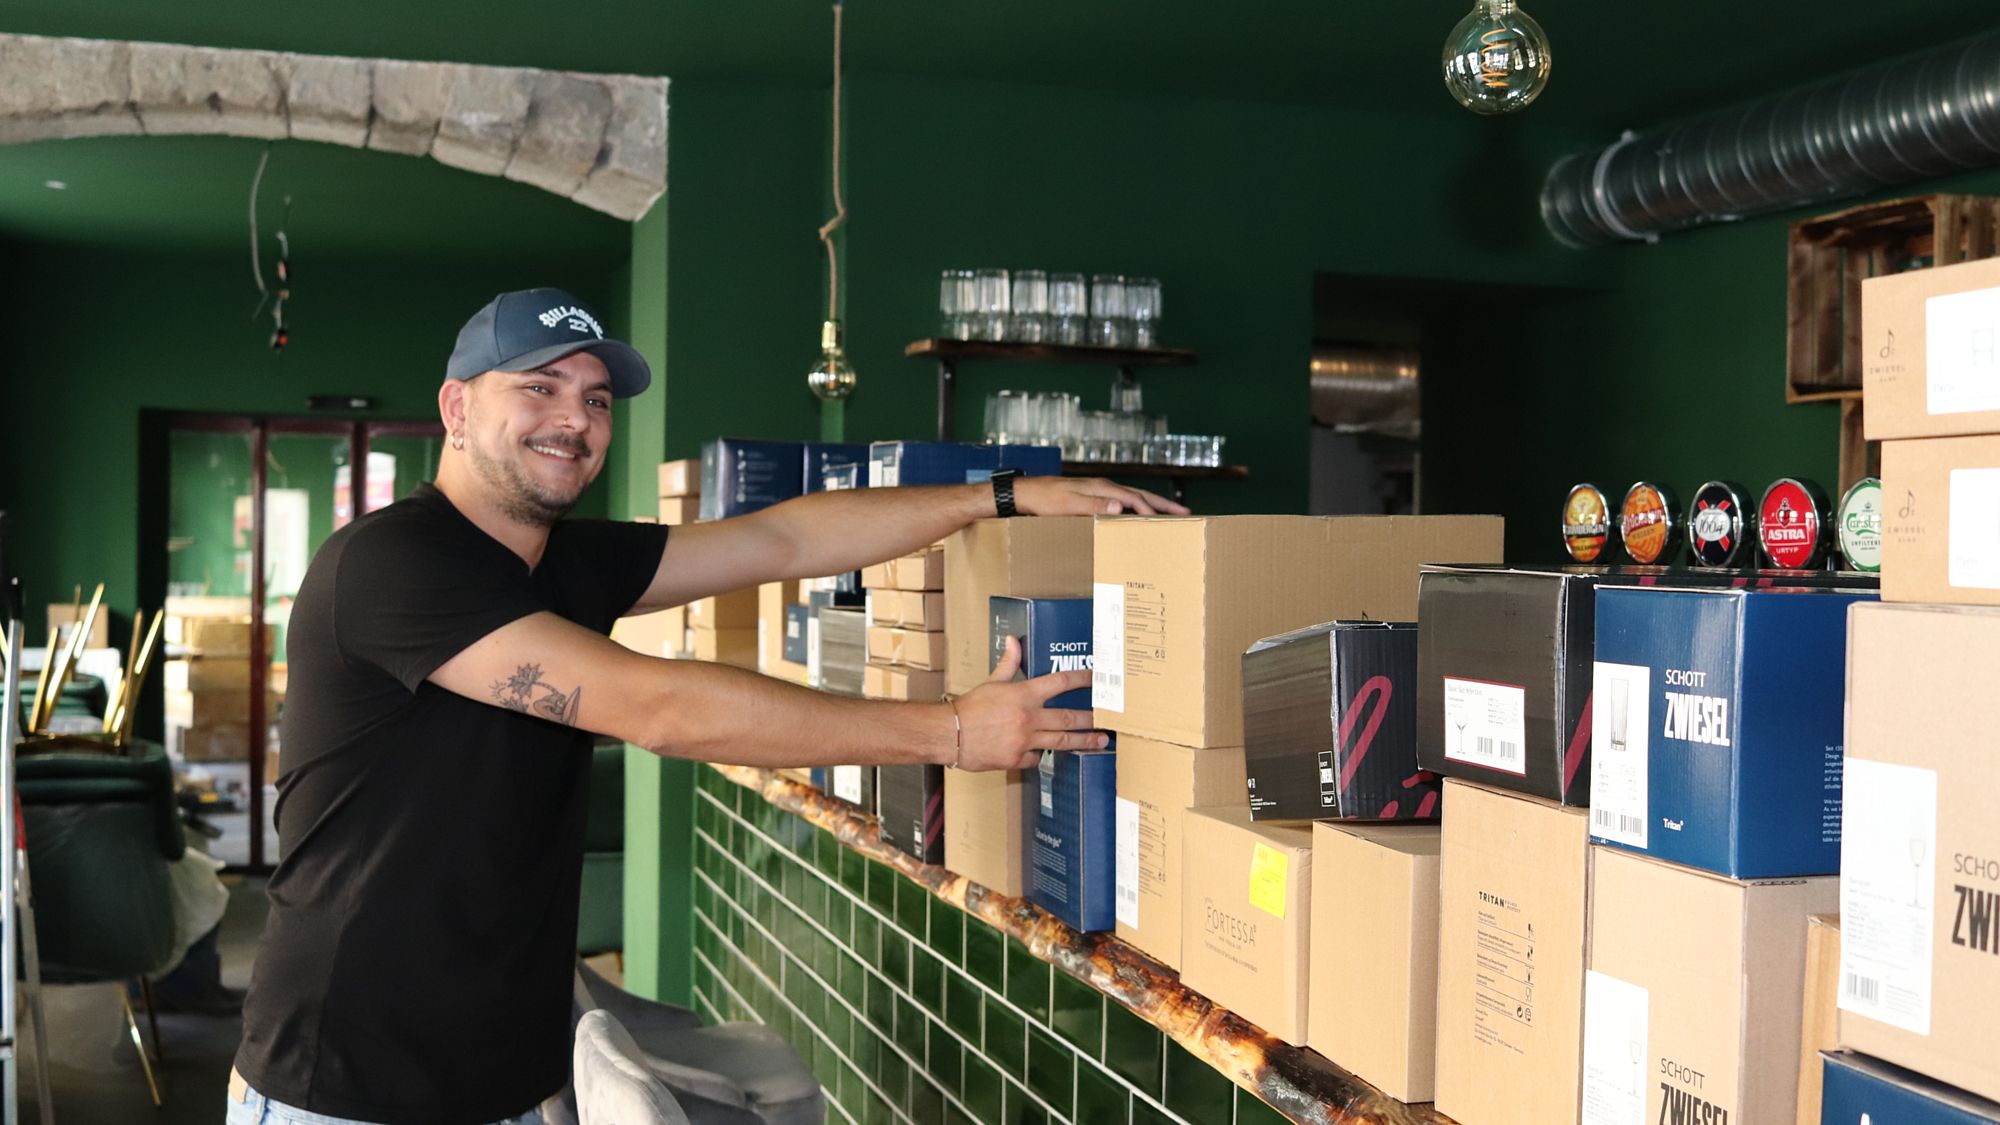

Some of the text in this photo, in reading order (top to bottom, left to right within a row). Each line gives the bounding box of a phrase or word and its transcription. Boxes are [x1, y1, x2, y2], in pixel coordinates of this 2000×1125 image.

[1768, 529, 1805, 540] ASTRA
[1050, 642, 1088, 652] SCHOTT
[1665, 669, 1706, 687] SCHOTT
[1664, 692, 1730, 746] ZWIESEL
[1954, 853, 2000, 881] SCHO
[1479, 891, 1505, 907] TRITAN
[1661, 1058, 1705, 1089] SCHOTT
